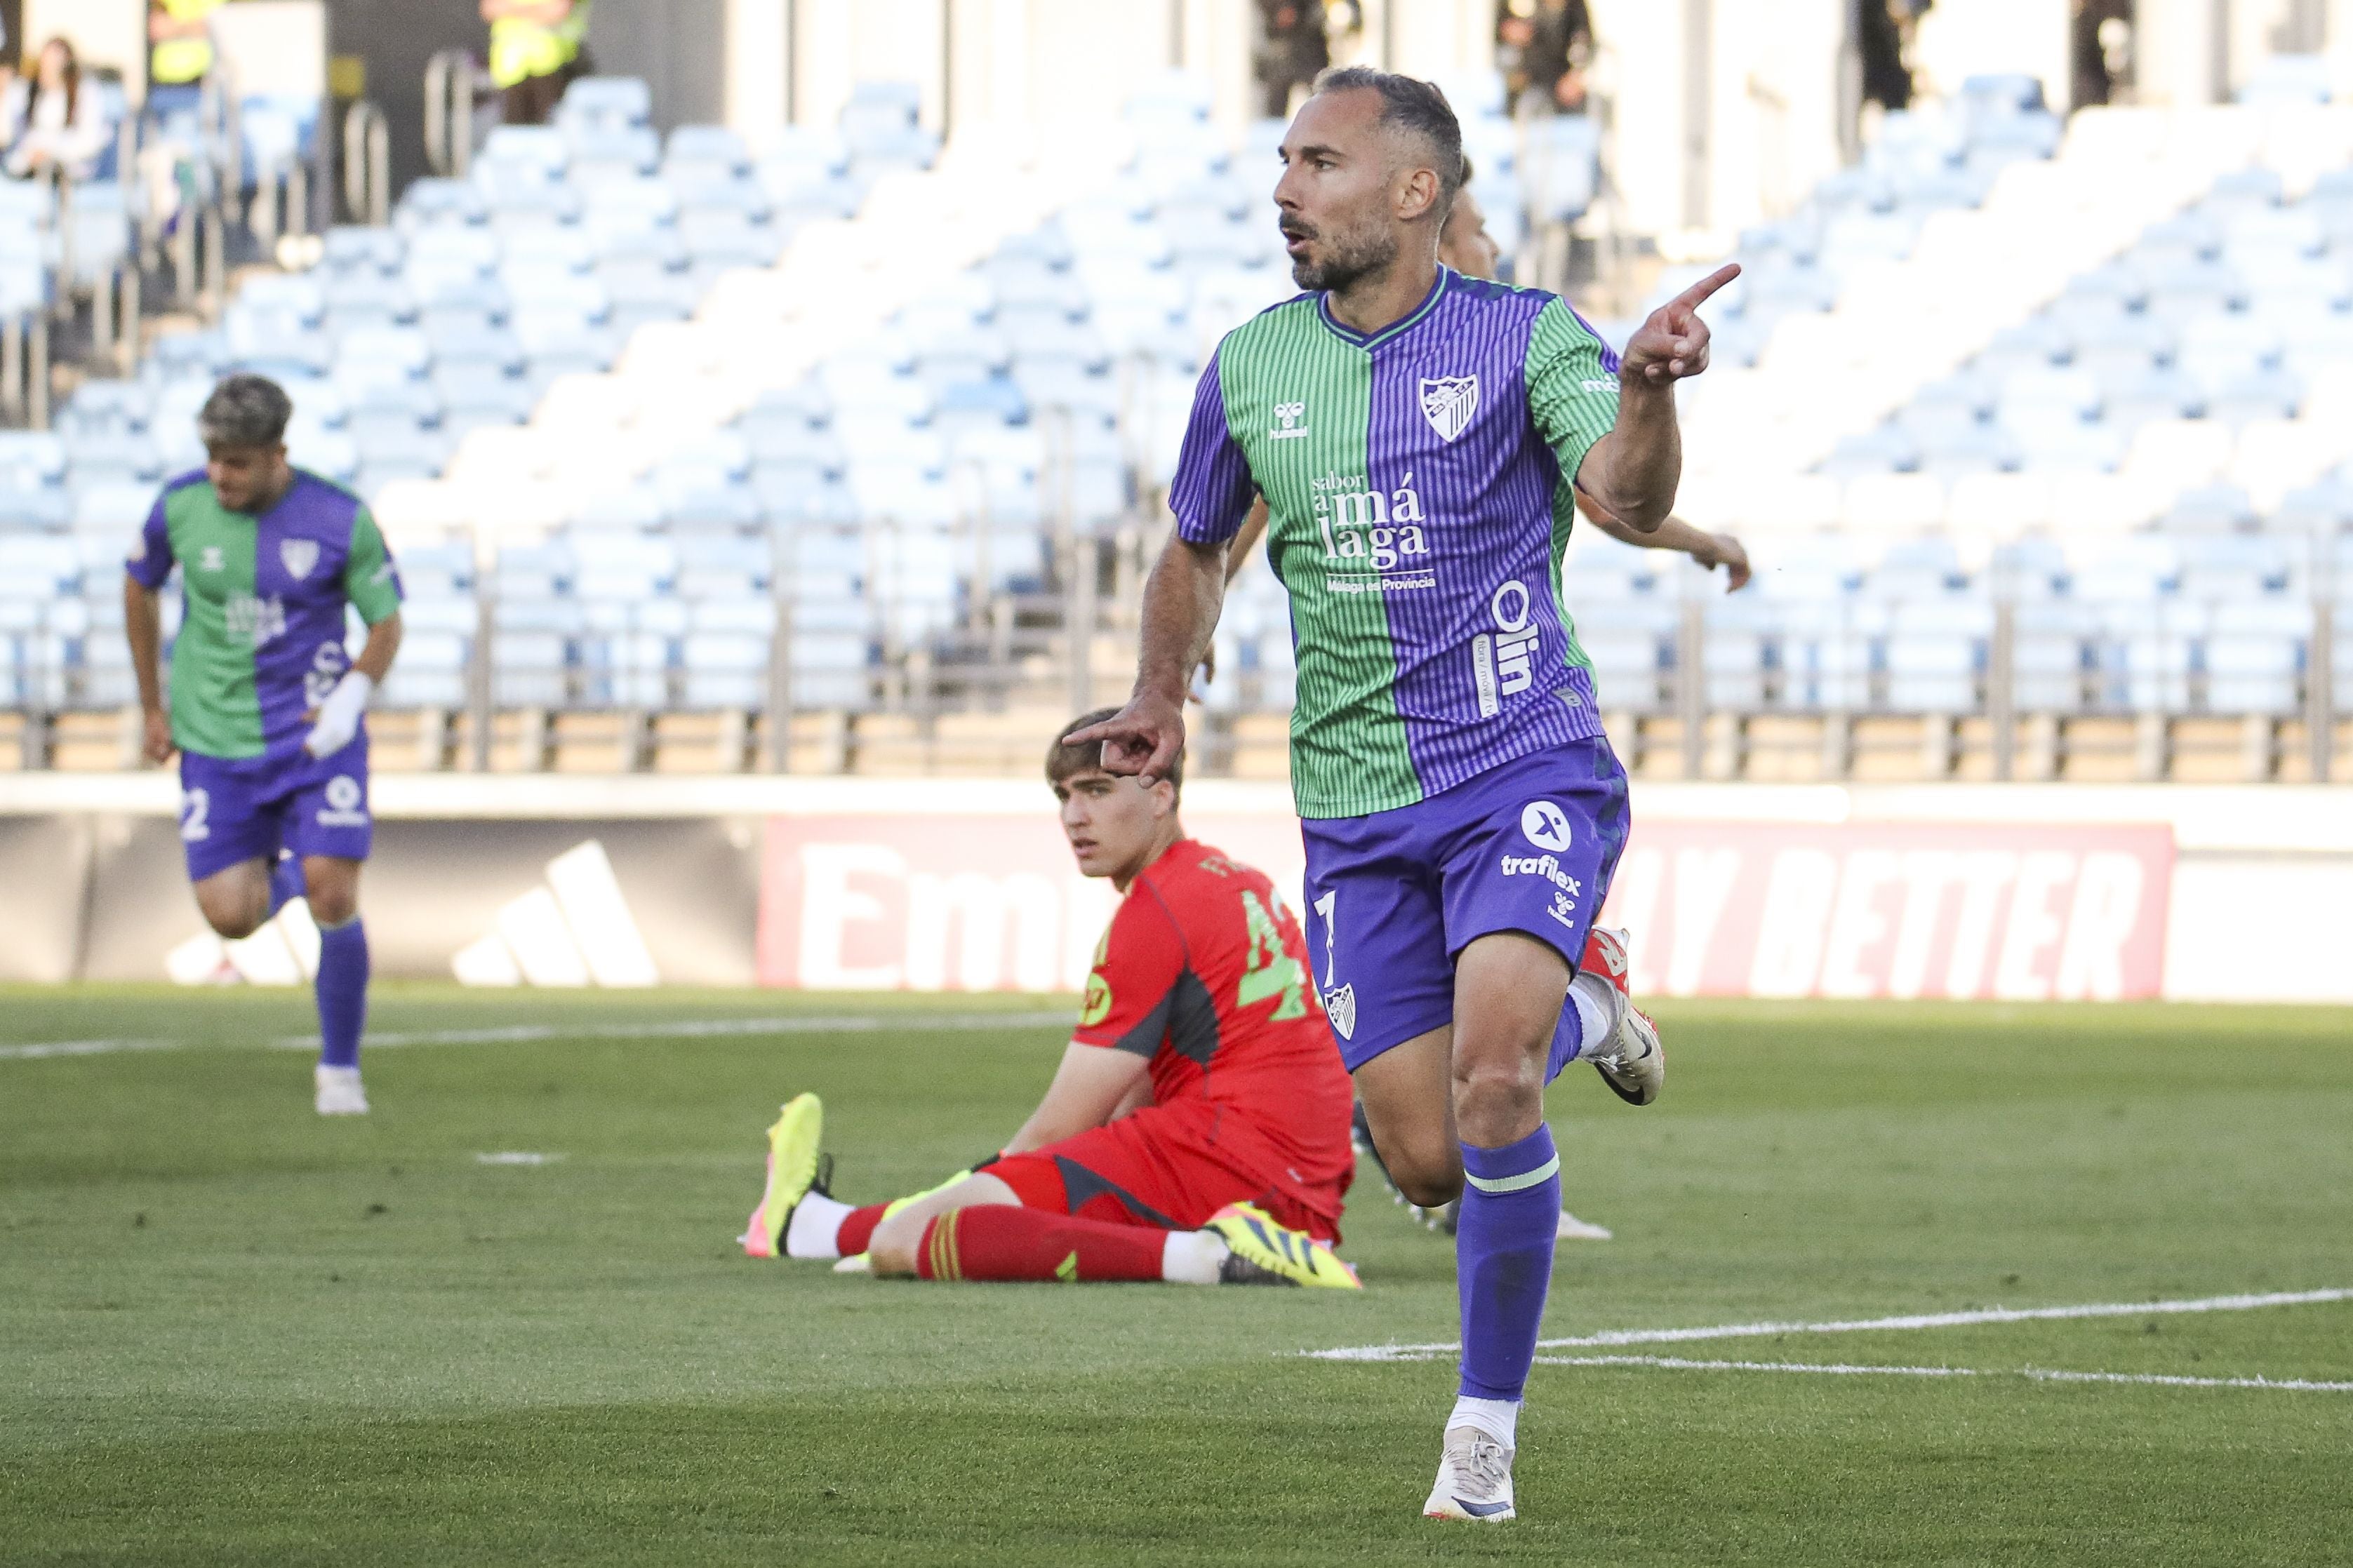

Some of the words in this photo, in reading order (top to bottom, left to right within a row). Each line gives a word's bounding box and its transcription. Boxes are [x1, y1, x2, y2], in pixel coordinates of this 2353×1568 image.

[1312, 471, 1364, 490] sabor
[1314, 495, 1329, 511] a
[1331, 471, 1426, 526] má
[1317, 515, 1430, 570] laga
[1327, 579, 1365, 594] Málaga
[1366, 582, 1380, 591] es
[1382, 577, 1436, 591] Provincia
[1492, 579, 1540, 696] Olin
[1480, 671, 1492, 697] móvil
[1614, 847, 1742, 998] LY
[1747, 847, 2144, 999] BETTER
